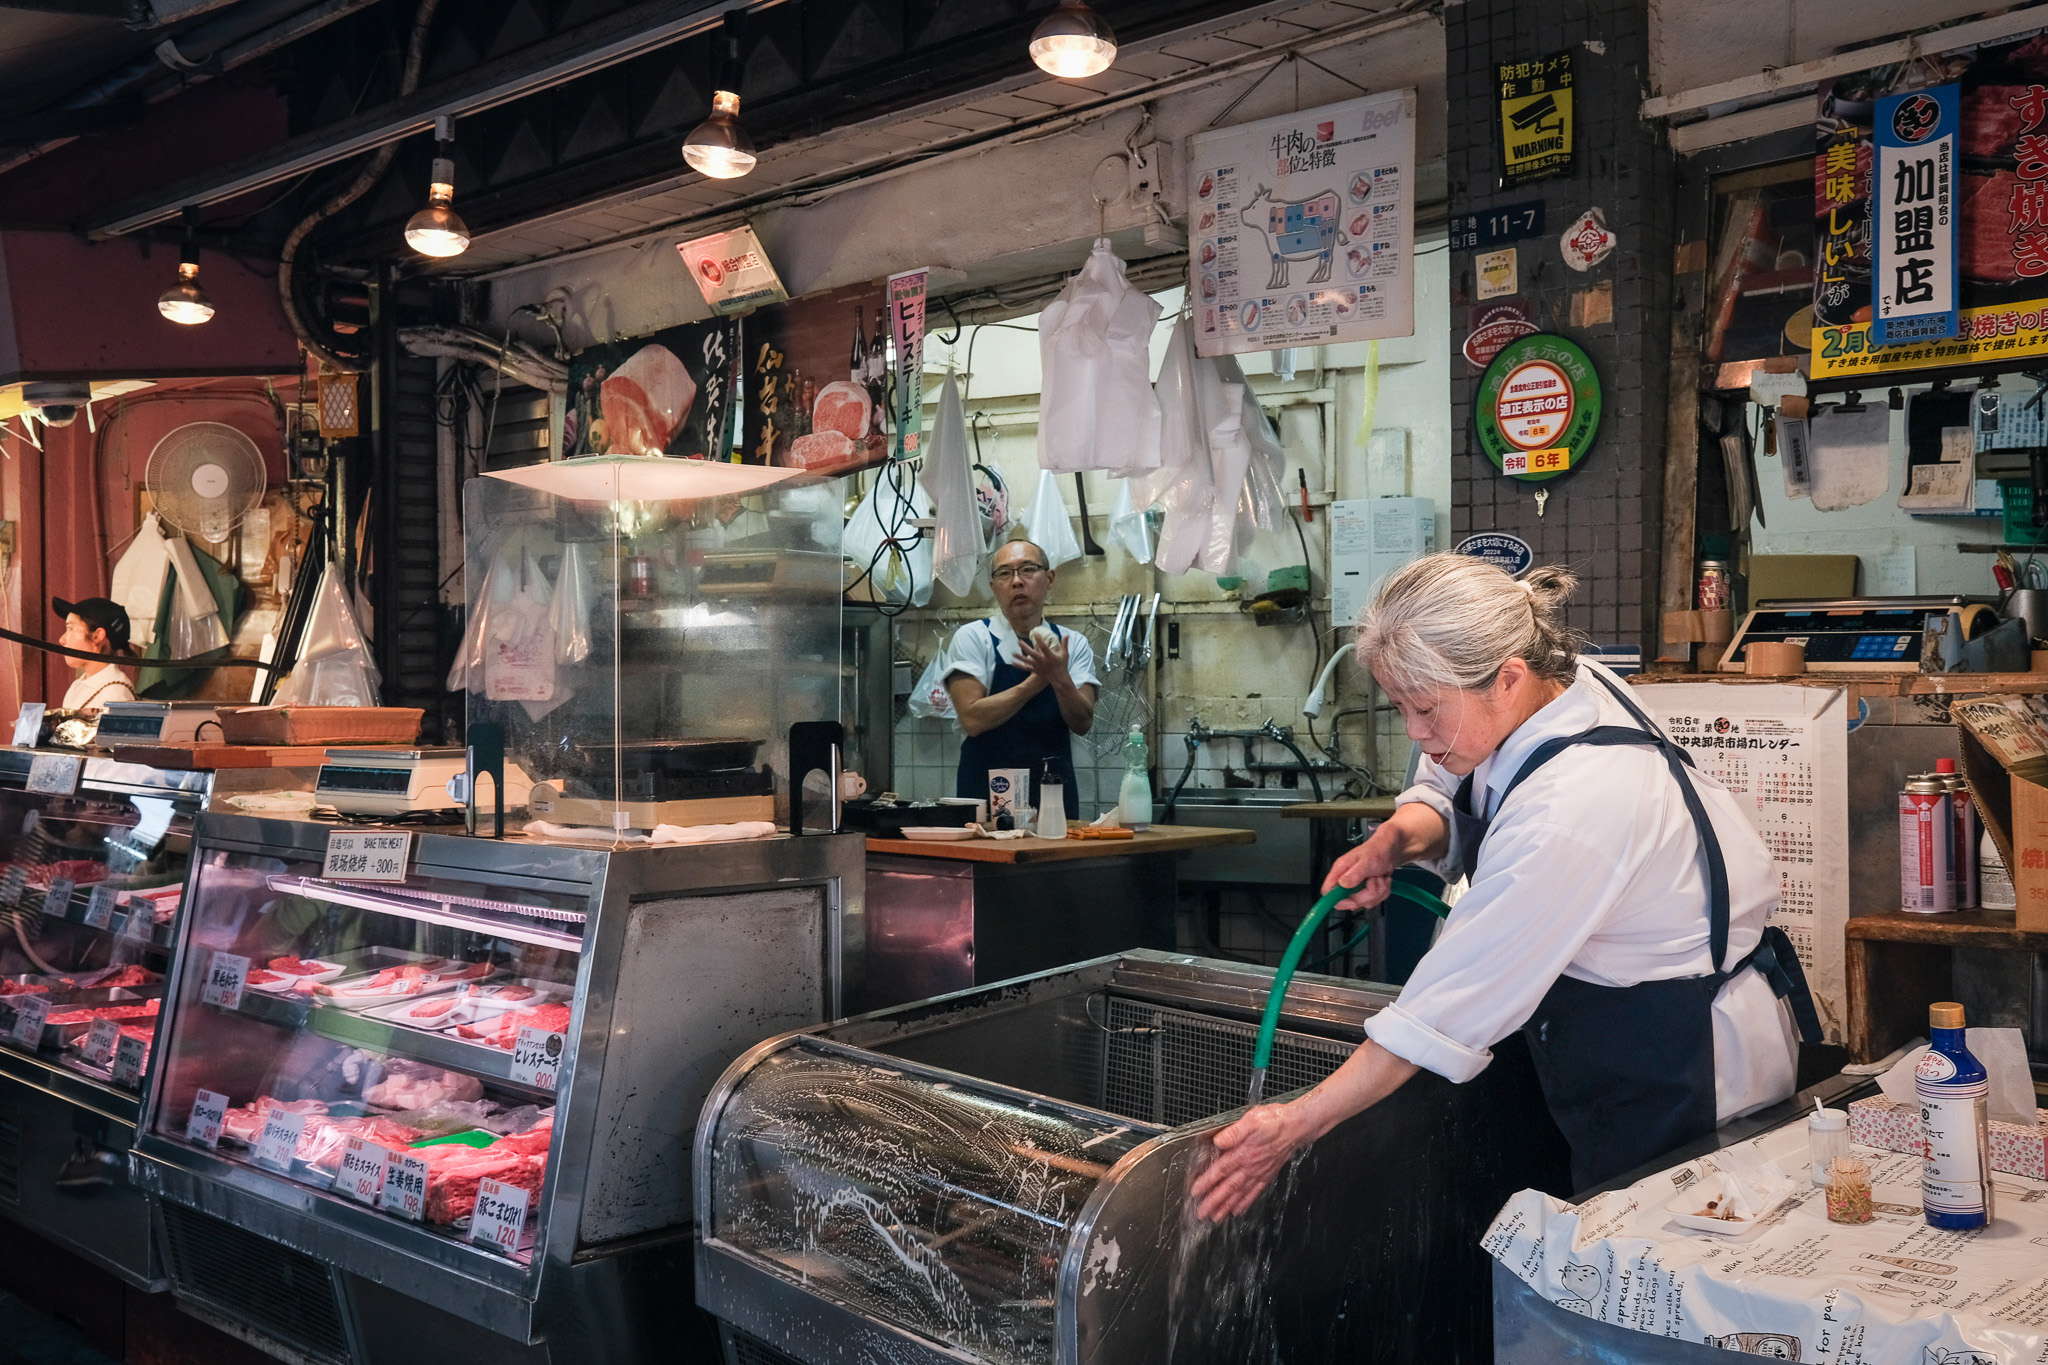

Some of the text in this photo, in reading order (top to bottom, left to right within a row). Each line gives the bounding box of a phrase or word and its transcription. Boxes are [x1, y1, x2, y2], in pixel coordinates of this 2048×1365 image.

[1501, 54, 1570, 80] 防犯カメラ
[1362, 102, 1403, 132] Beef
[1269, 129, 1316, 159] 牛肉の
[1512, 136, 1564, 160] WARNING
[1277, 148, 1336, 176] 部位と特徴
[1938, 142, 1949, 226] 当店は振興組合の
[1490, 210, 1536, 236] 11-7
[1894, 158, 1934, 306] 加盟店
[1882, 295, 1892, 316] です
[1886, 316, 1946, 330] 築地場外市場
[1886, 327, 1946, 340] 商店街振興組合
[900, 302, 916, 424] ヒレステーキ
[1488, 344, 1588, 394] 適正表示の店
[755, 342, 783, 466] 仙台牛
[1500, 396, 1568, 416] 適正表示の店
[1504, 454, 1560, 470] 令和 6年
[1668, 716, 1700, 726] 令和6年
[364, 838, 377, 848] BAKE
[378, 838, 388, 849] THE
[388, 838, 403, 849] MEAT
[329, 854, 367, 872] 现场烧烤
[211, 970, 238, 990] 黒毛和牛
[515, 1049, 559, 1072] ヒレステーキ
[343, 1153, 381, 1178] 豚ももスライス
[387, 1166, 423, 1196] 生姜焼用
[477, 1196, 521, 1226] 豚こま切れ
[1504, 1211, 1524, 1235] herbs
[1530, 1266, 1540, 1278] our
[1632, 1245, 1653, 1322] kinds of bread
[1617, 1269, 1632, 1324] spreads
[1650, 1278, 1660, 1306] dogs
[1816, 1329, 1831, 1354] for
[1855, 1325, 1865, 1347] how
